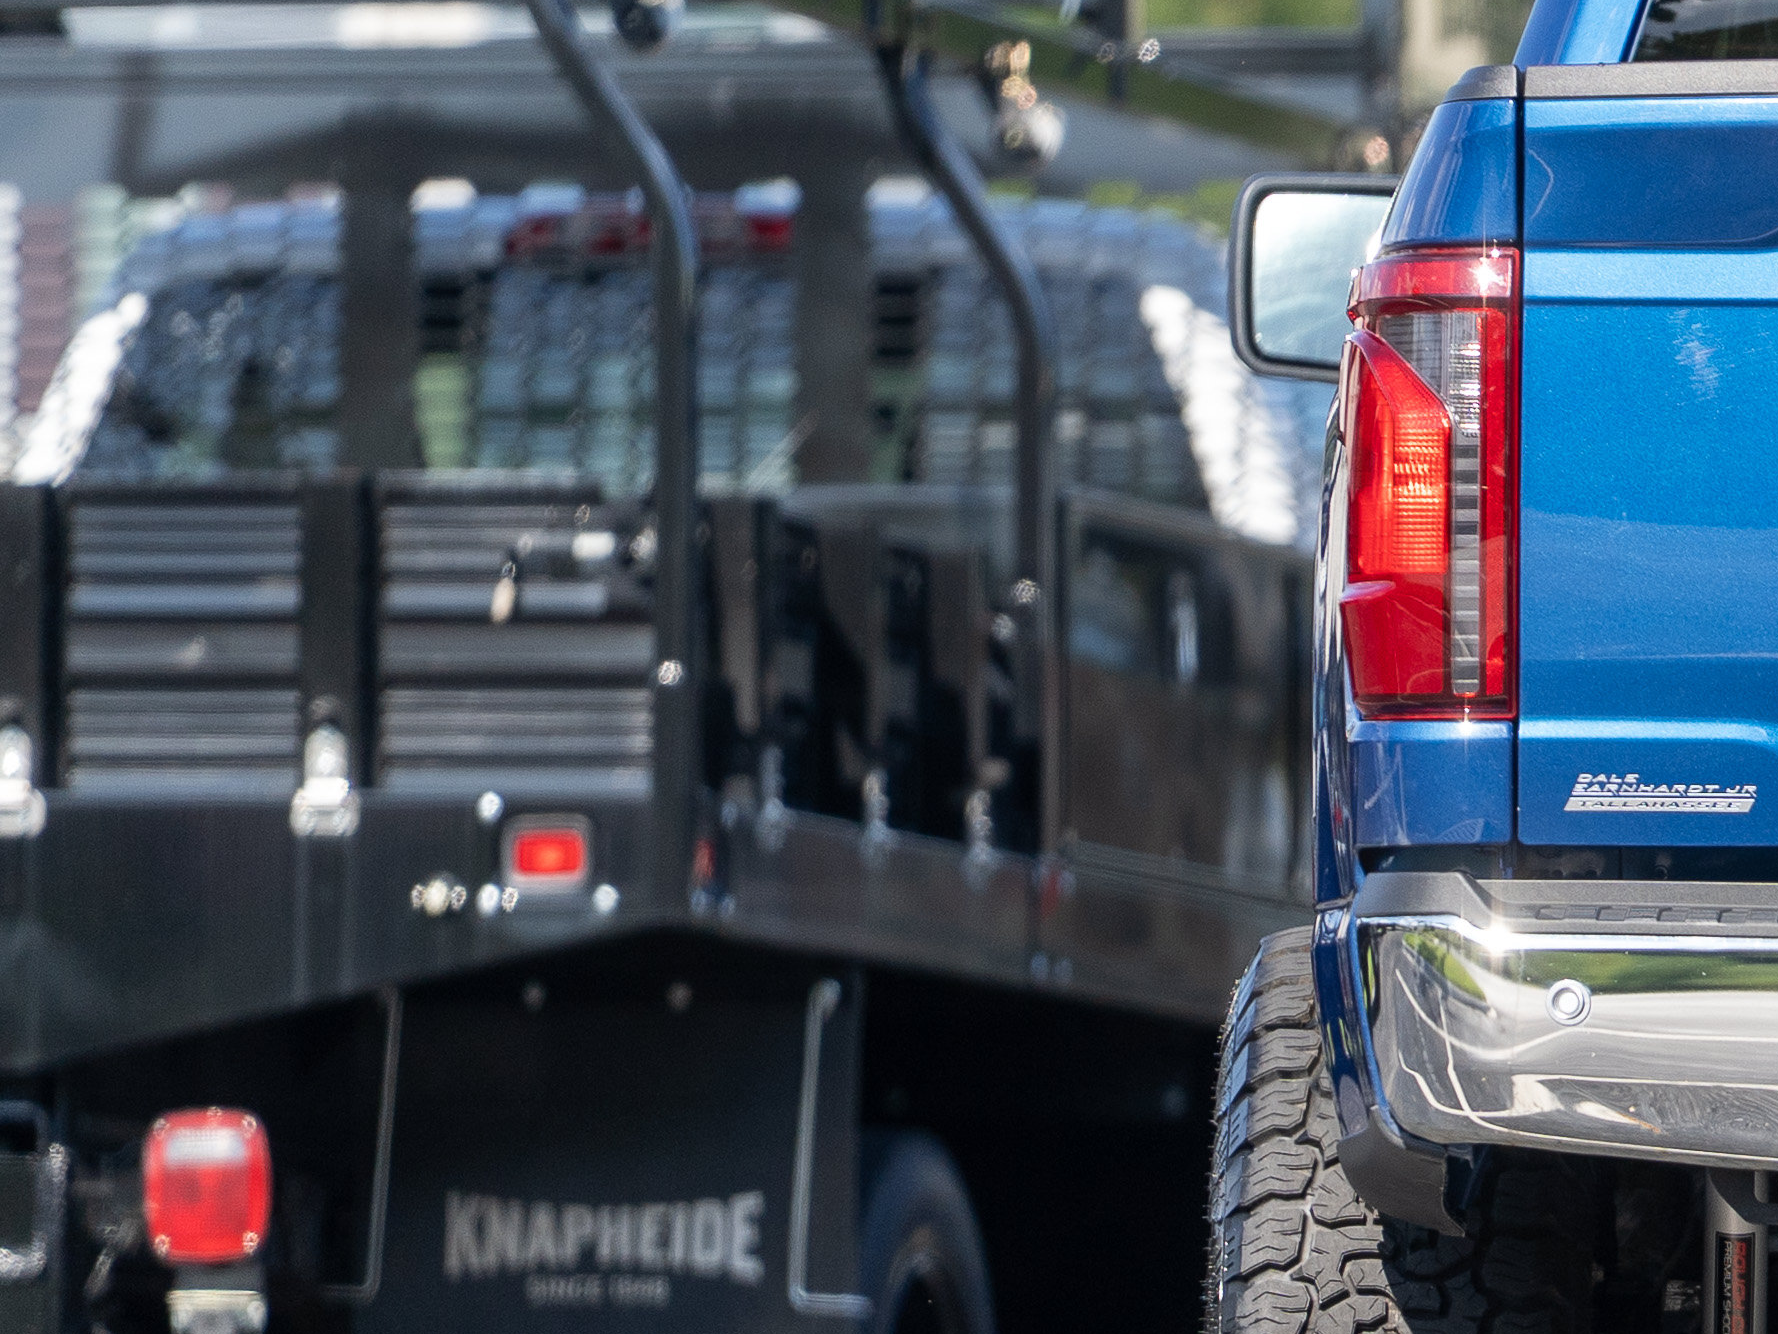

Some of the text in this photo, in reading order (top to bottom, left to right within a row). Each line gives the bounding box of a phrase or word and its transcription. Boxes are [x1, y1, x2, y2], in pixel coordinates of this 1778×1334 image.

[1576, 773, 1640, 783] DALE
[1573, 784, 1757, 797] EARNHARDT JR
[1579, 799, 1741, 809] TALLAHASSEE
[444, 1190, 765, 1280] KNAPHEIDE
[1723, 1240, 1732, 1297] PREMIUM
